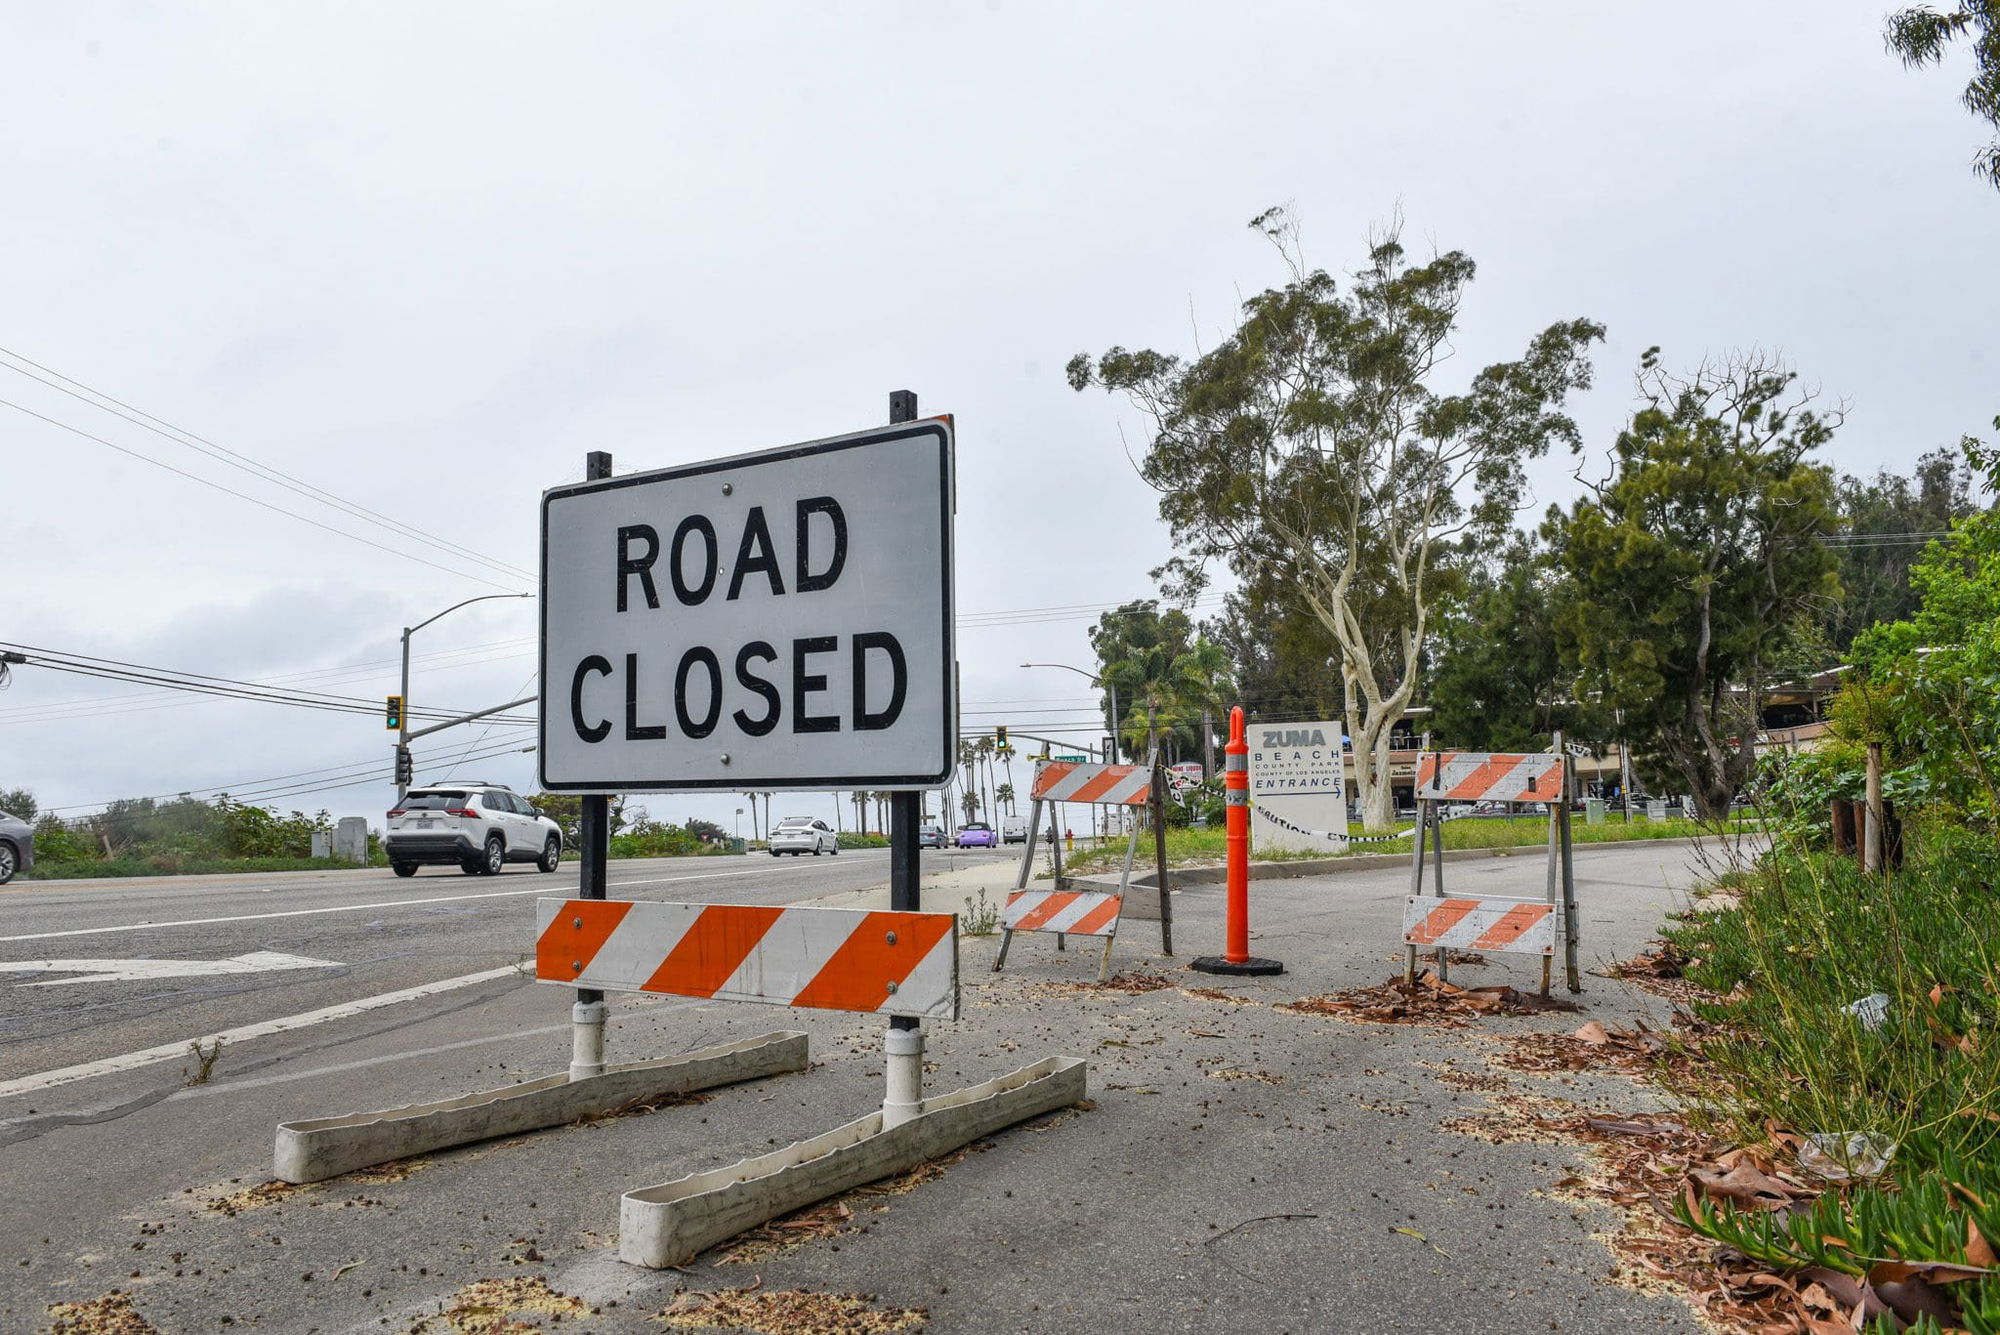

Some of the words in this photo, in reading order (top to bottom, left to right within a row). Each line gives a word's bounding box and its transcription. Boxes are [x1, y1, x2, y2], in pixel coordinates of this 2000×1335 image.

[617, 496, 848, 613] ROAD
[571, 631, 908, 744] CLOSED
[1263, 729, 1326, 748] ZUMA
[1254, 750, 1340, 761] BEACH
[1255, 777, 1341, 789] ENTRANCE
[1257, 805, 1311, 836] CAUTION
